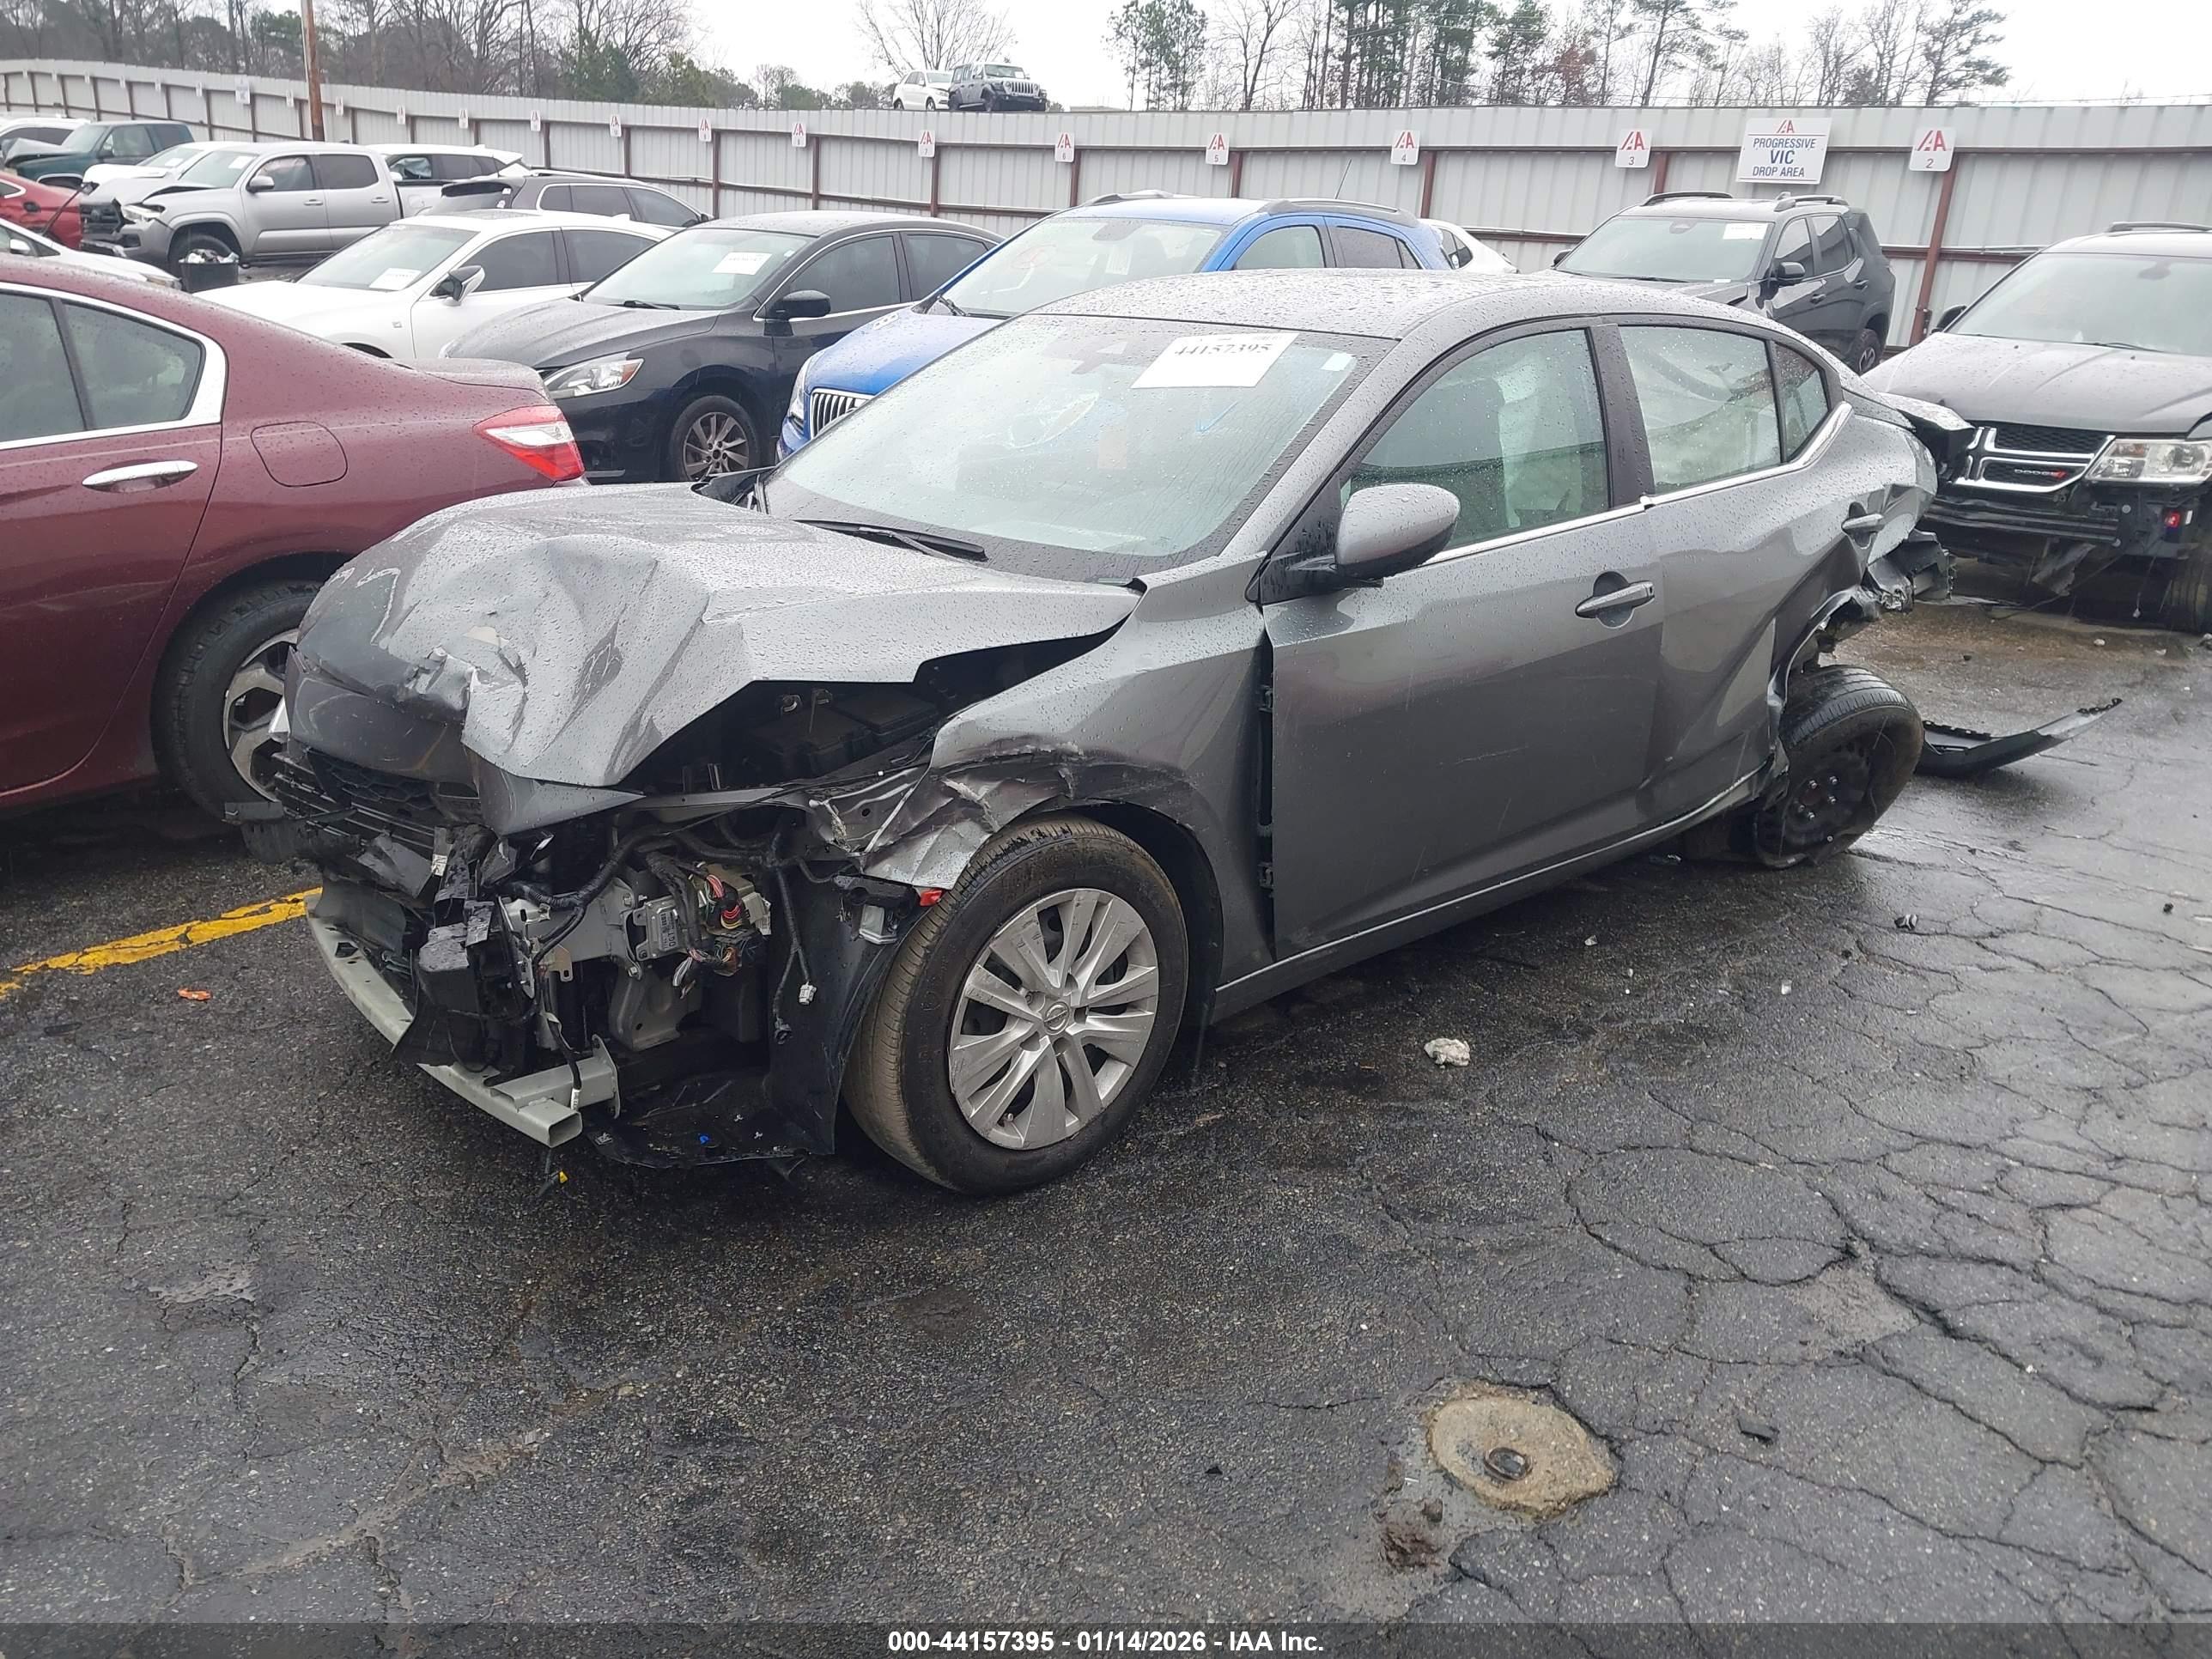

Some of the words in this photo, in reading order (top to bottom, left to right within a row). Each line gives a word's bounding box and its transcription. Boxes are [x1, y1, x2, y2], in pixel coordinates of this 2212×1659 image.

[1753, 137, 1816, 149] PROGRESSIVE
[1214, 154, 1219, 162] 5
[1401, 154, 1407, 162] 4
[1628, 156, 1635, 166] 3
[1770, 149, 1795, 164] VIC
[1925, 158, 1934, 168] 2
[1753, 166, 1778, 177] DROP
[1779, 167, 1804, 177] AREA
